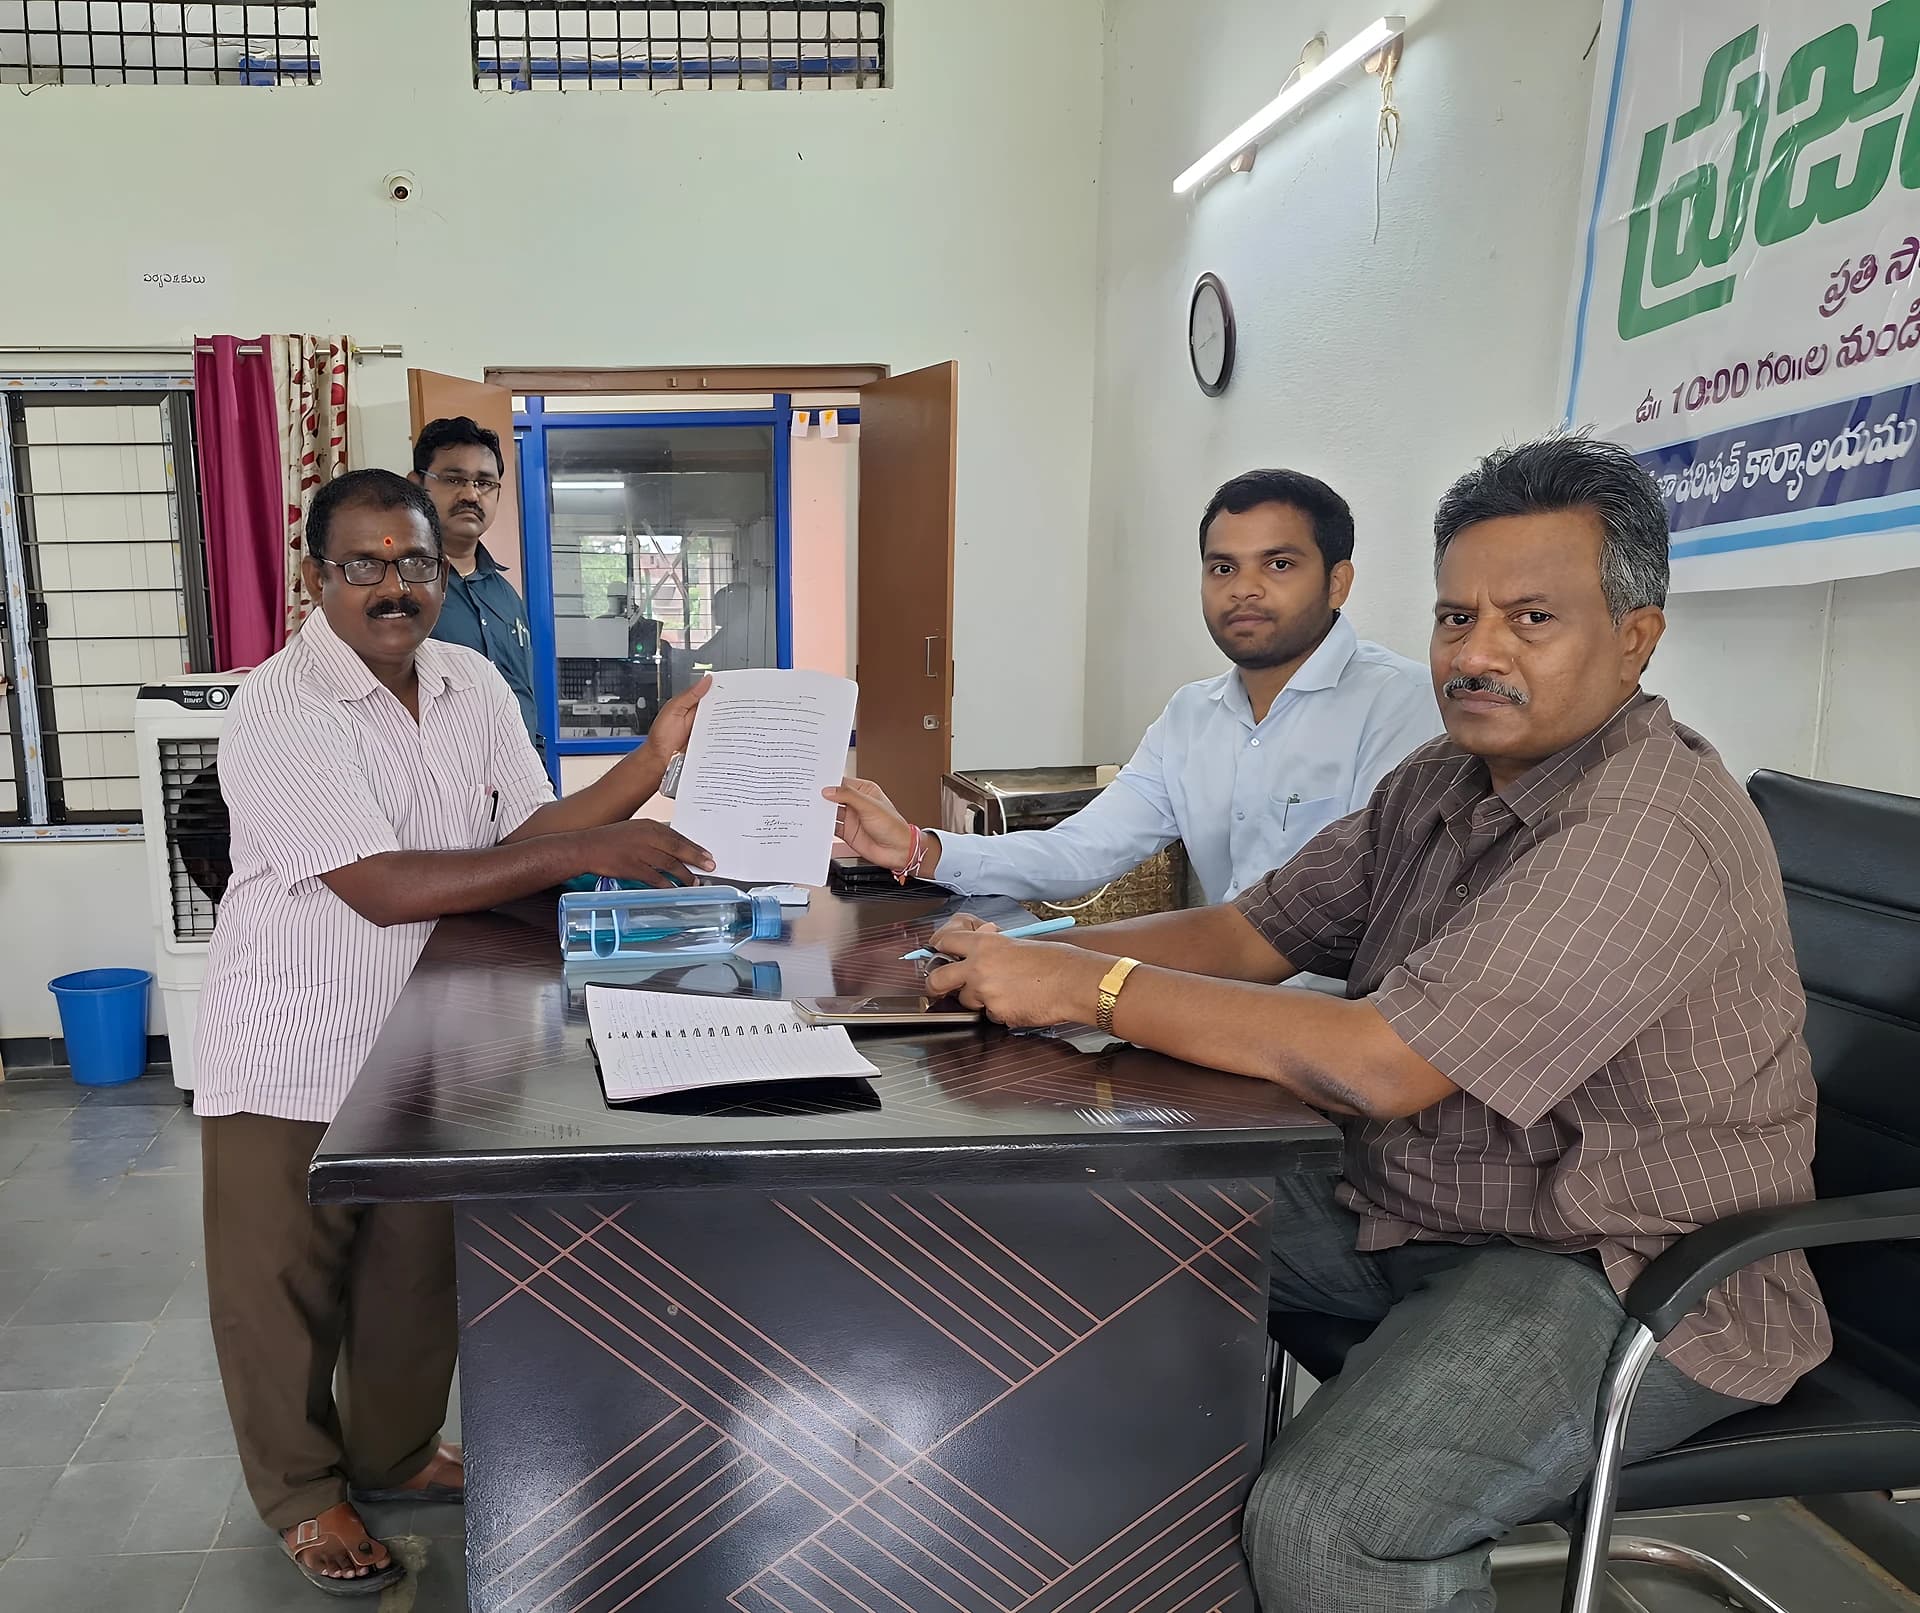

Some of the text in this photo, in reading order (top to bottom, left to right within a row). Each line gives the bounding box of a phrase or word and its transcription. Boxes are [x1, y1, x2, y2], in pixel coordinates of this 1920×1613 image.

[1819, 254, 1878, 318] ప్రతి
[1672, 362, 1750, 413] 10:00
[1743, 413, 1918, 501] కార్యాలయము
